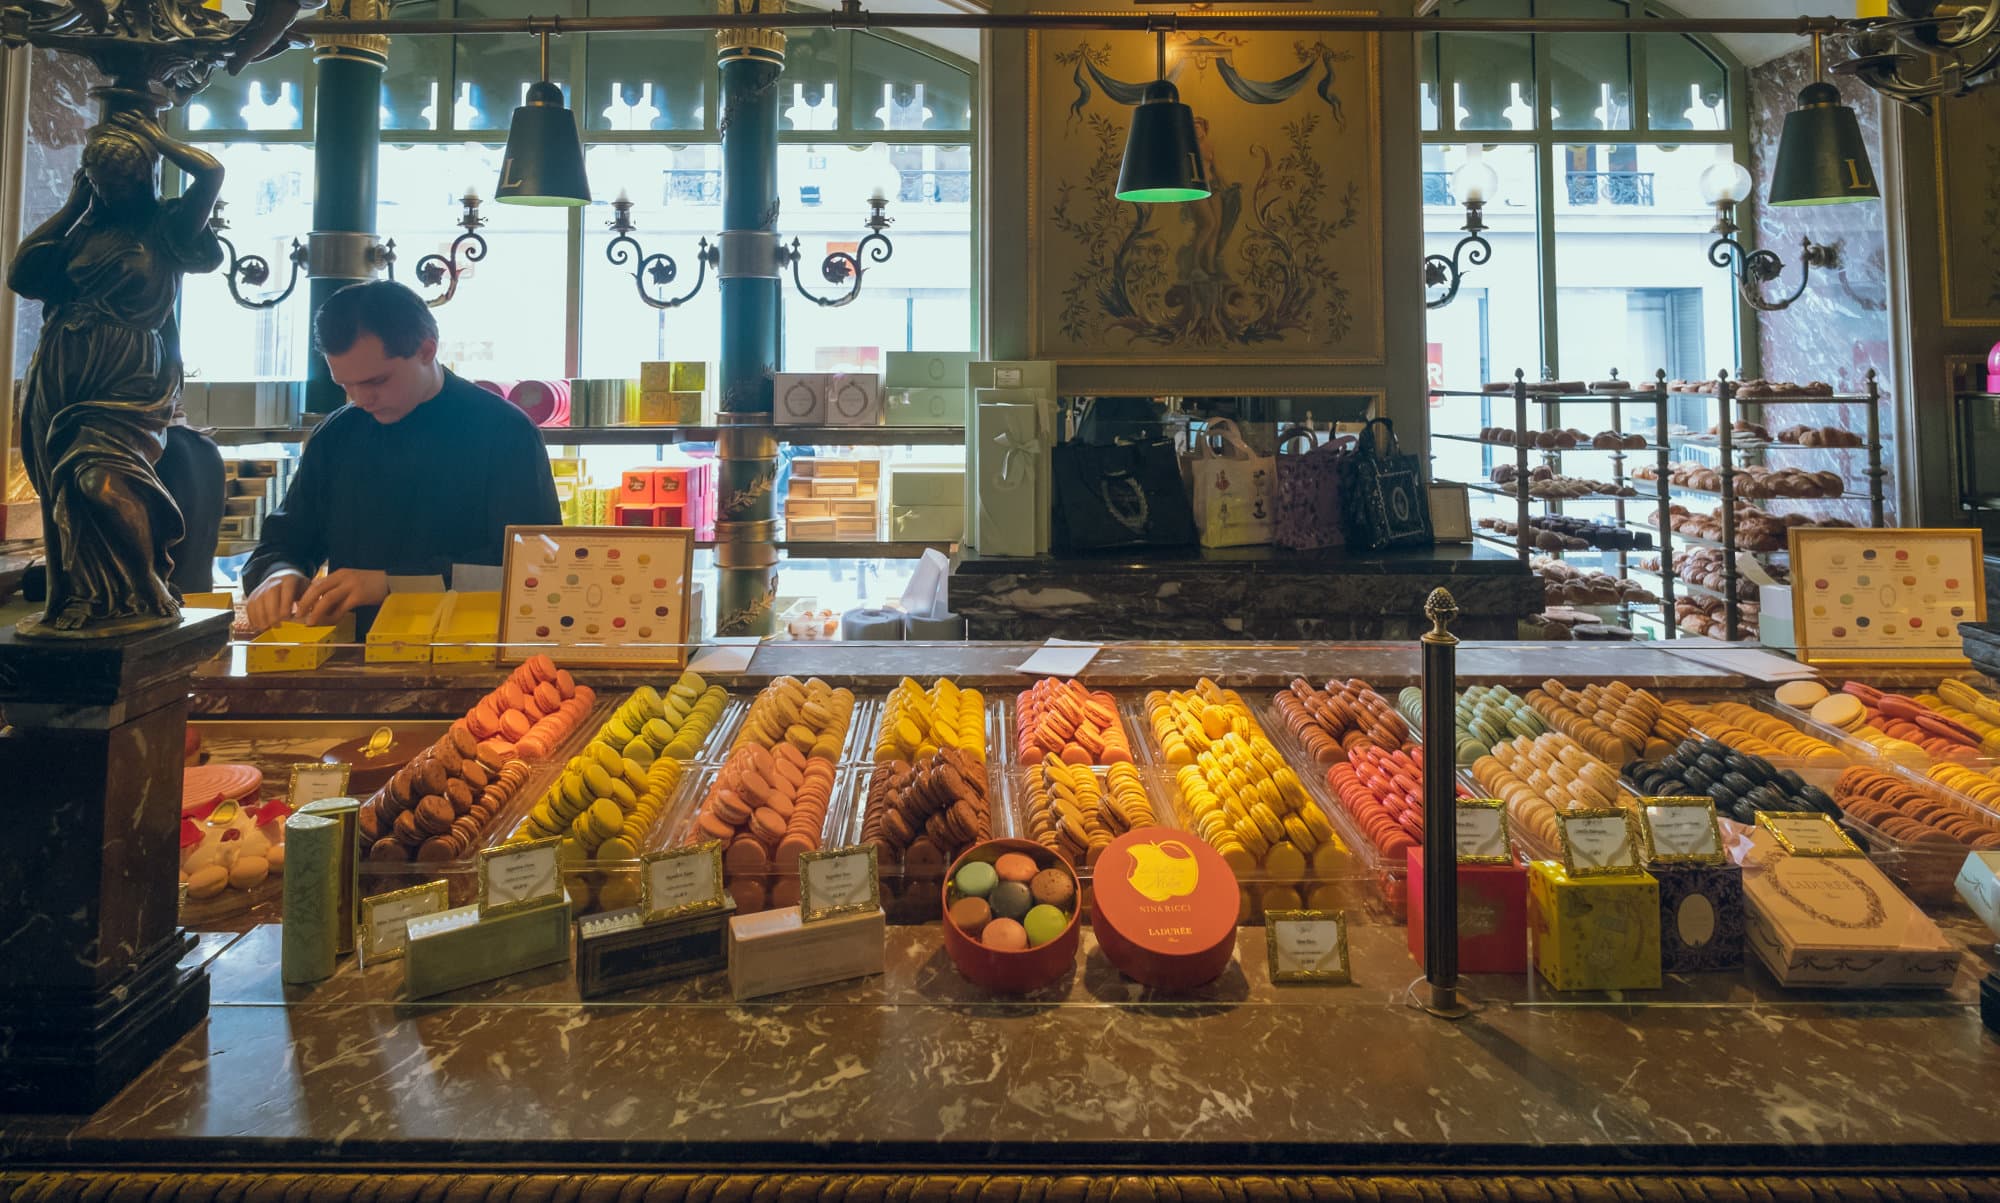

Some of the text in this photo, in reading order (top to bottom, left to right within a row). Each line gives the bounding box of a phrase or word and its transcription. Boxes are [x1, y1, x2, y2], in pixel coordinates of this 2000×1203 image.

[500, 158, 523, 189] L
[1844, 158, 1872, 189] L
[1139, 904, 1191, 913] NINA RICCI
